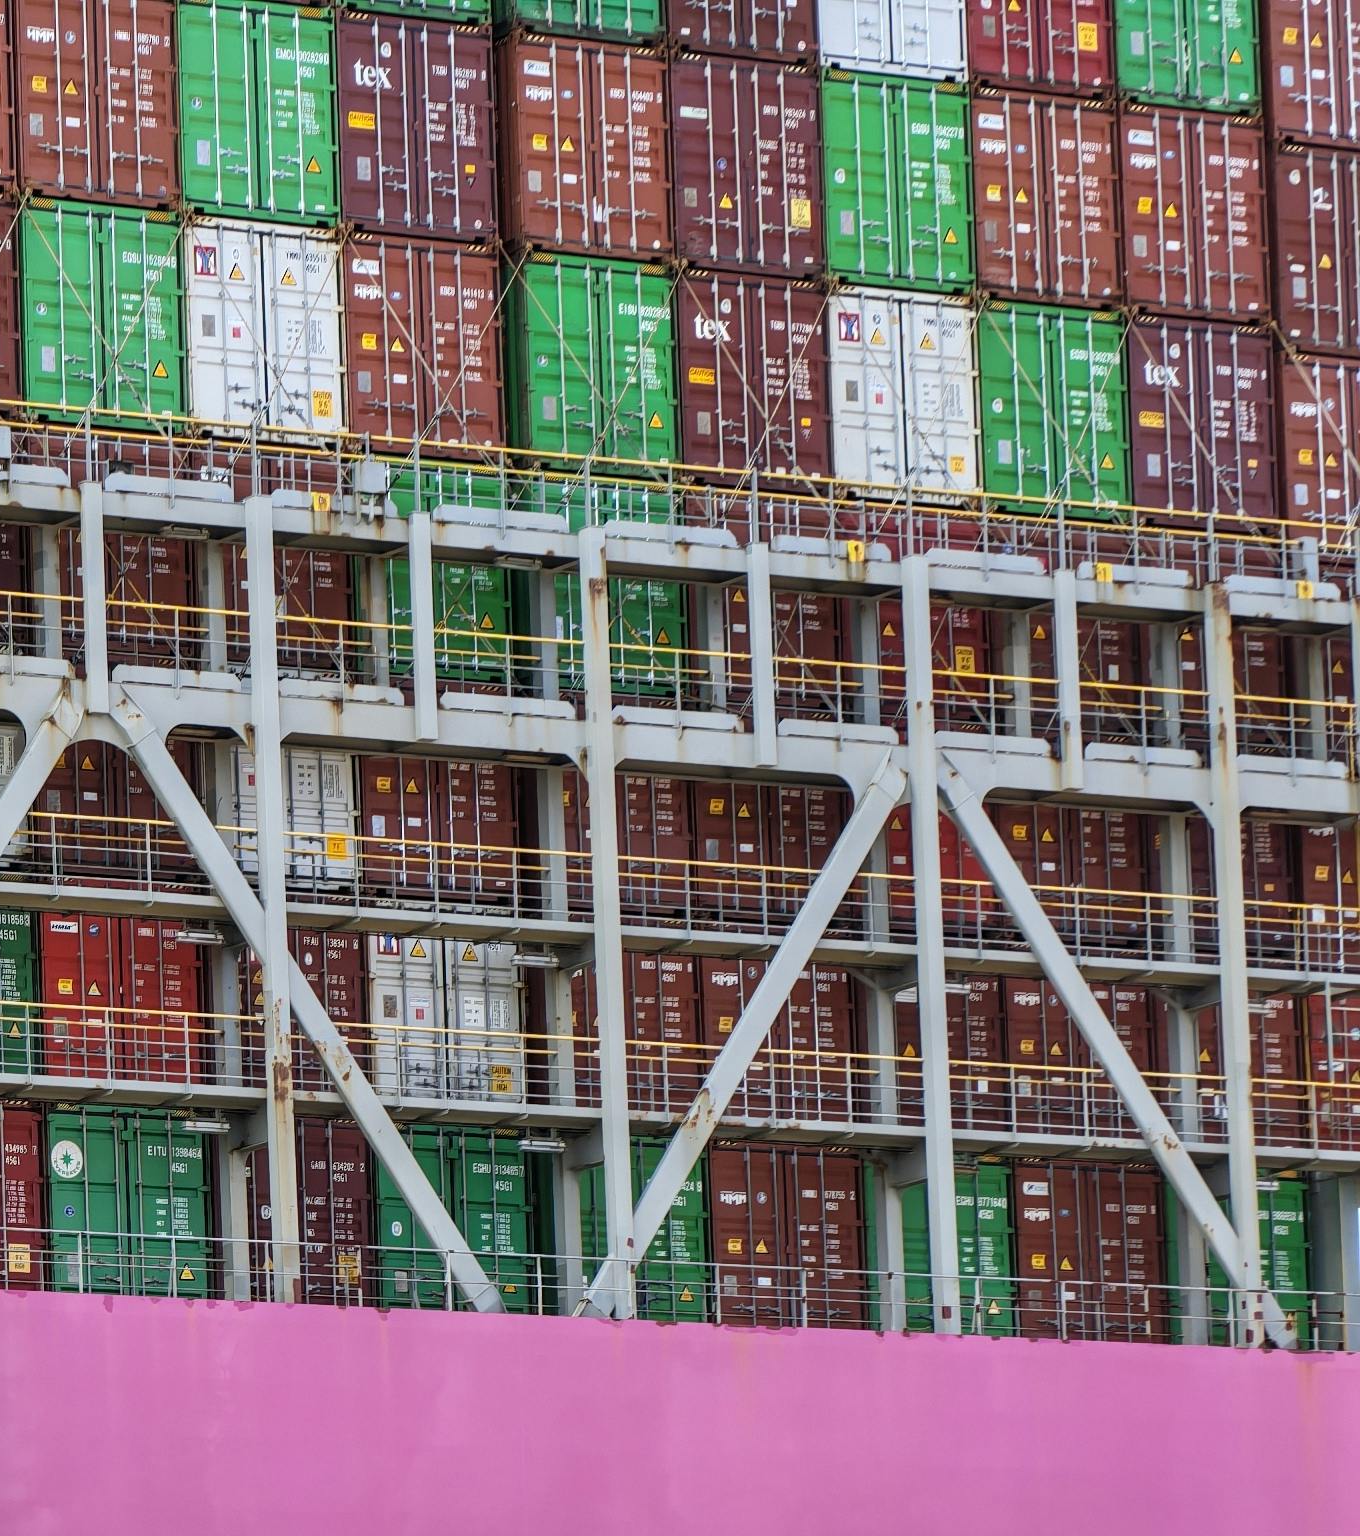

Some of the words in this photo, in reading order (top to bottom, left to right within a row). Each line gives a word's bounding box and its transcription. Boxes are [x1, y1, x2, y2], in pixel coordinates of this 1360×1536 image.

[354, 58, 392, 89] tex
[694, 311, 732, 342] tex
[1144, 363, 1181, 386] tex
[0, 930, 17, 940] 45G1
[492, 1066, 511, 1074] CAUTION
[5, 1143, 27, 1153] 434985
[148, 1146, 166, 1156] EITU
[5, 1156, 20, 1165] 45G1
[172, 1162, 188, 1173] 45G1
[720, 1191, 746, 1205] HMM
